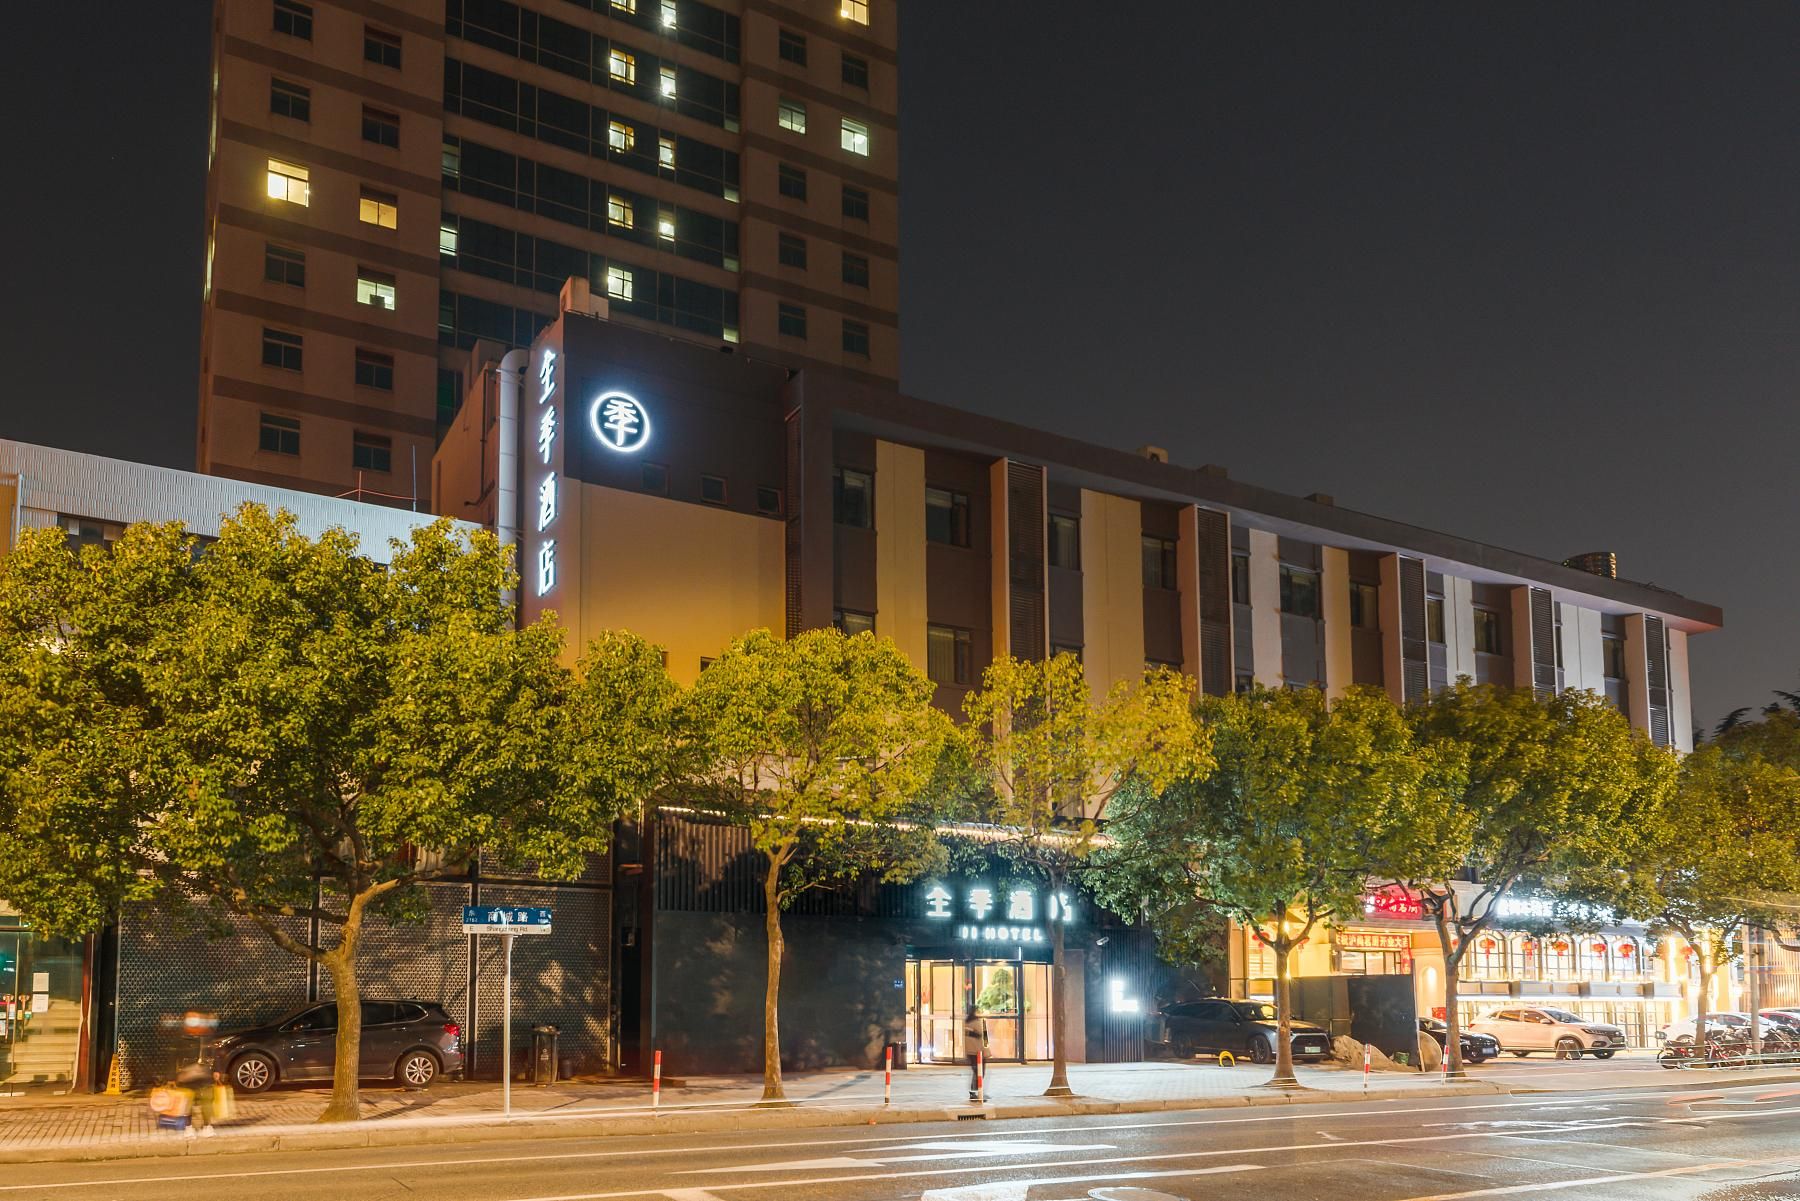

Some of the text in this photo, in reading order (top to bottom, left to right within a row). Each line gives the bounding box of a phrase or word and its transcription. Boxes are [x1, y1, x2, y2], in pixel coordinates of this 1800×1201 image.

[603, 399, 639, 447] 季
[538, 349, 557, 597] 全季酒店
[984, 927, 1043, 942] HOTEL
